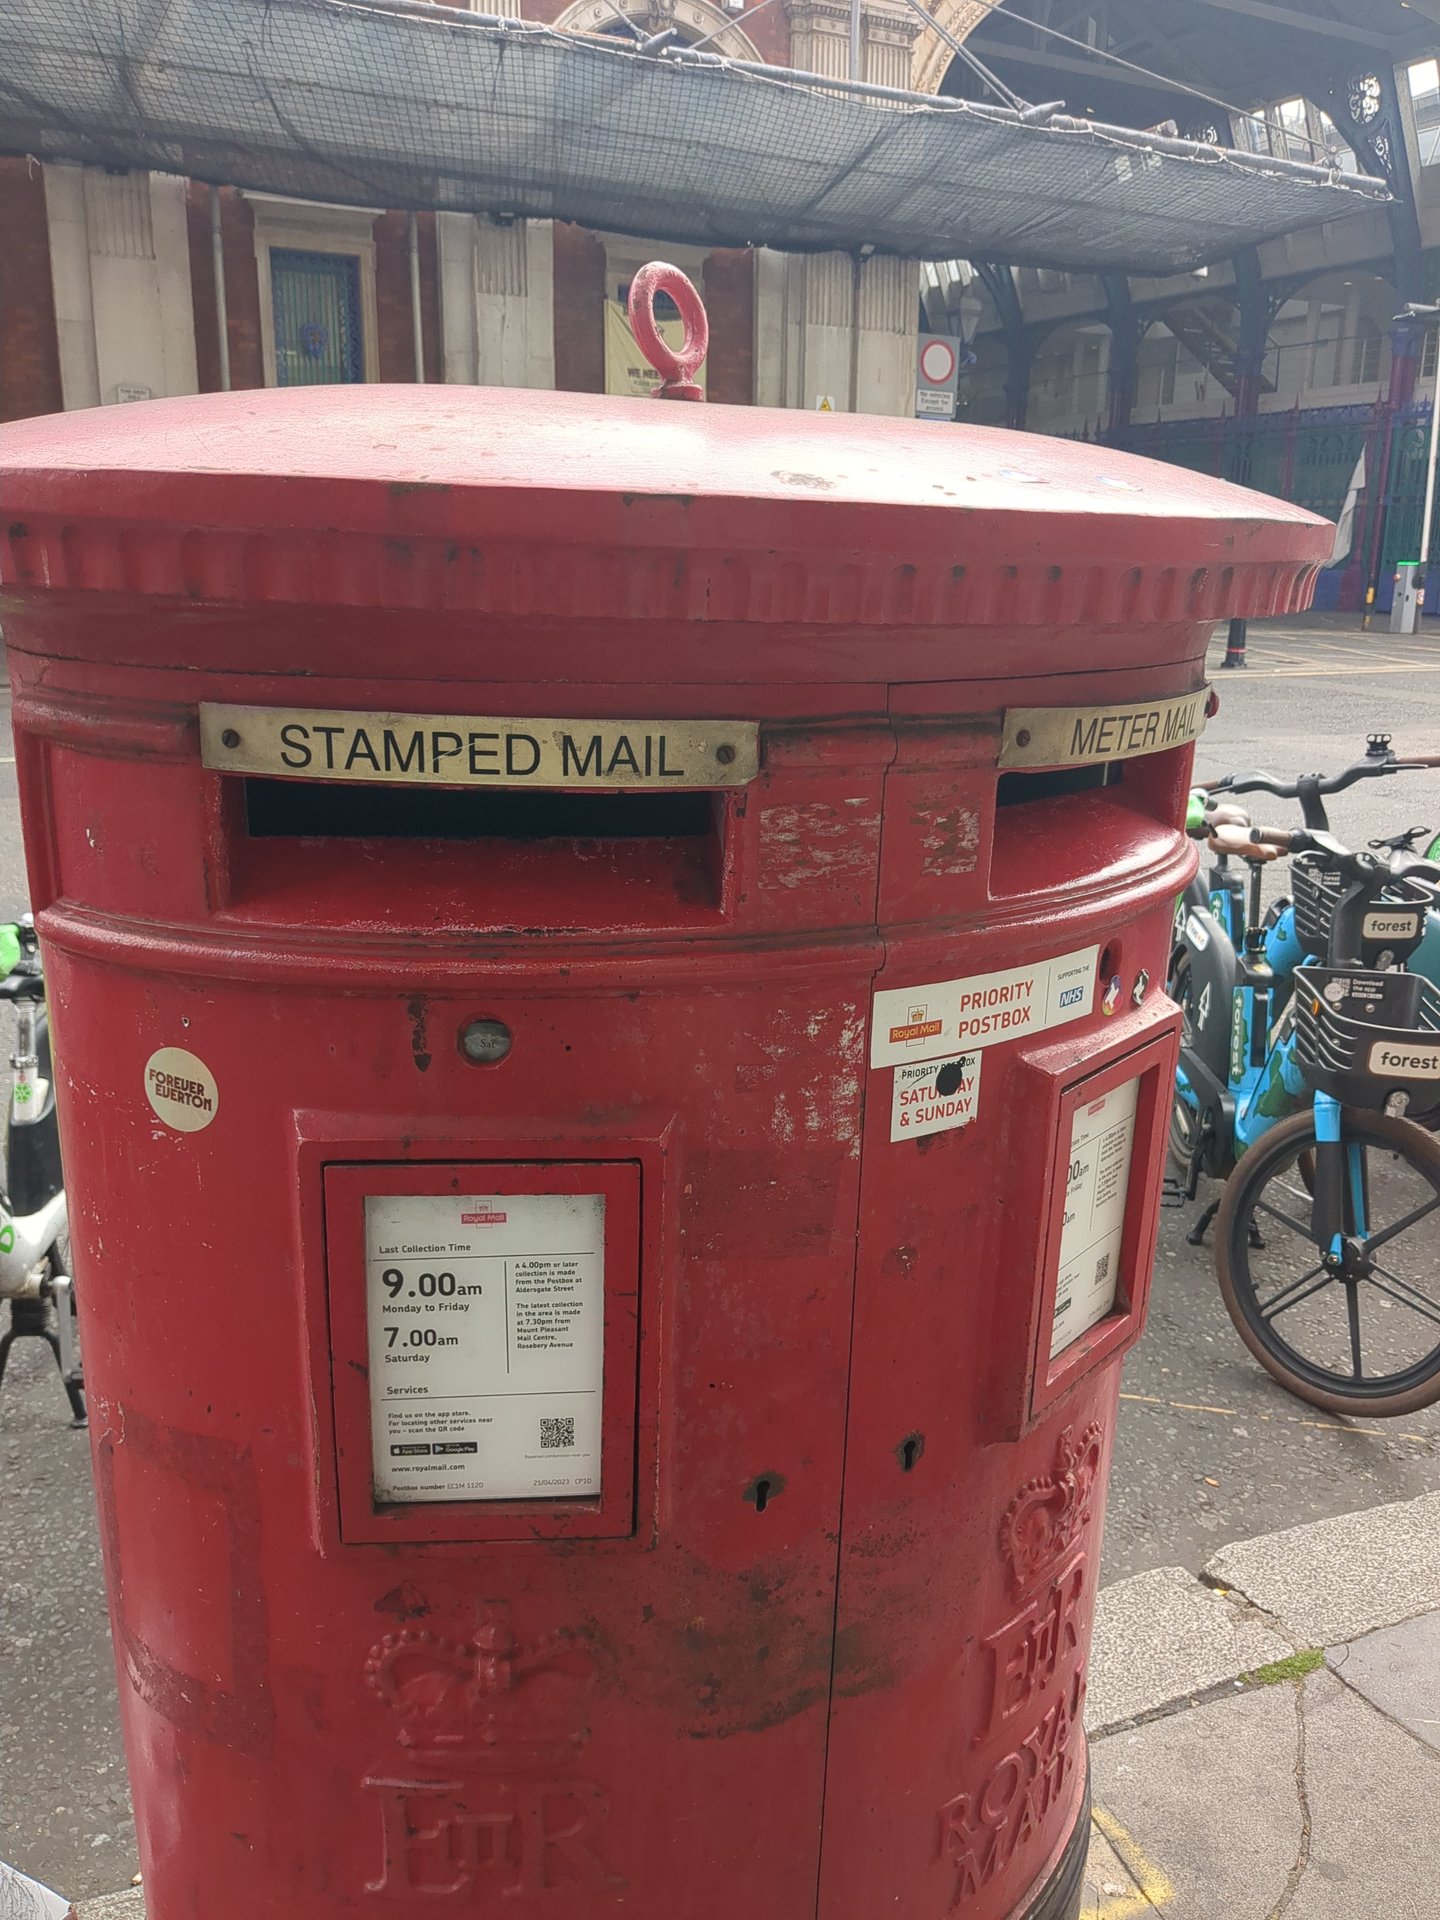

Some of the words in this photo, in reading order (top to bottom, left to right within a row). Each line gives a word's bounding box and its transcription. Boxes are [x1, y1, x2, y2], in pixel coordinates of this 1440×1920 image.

[1070, 711, 1160, 755] METER
[1161, 703, 1196, 743] MAIL
[280, 724, 541, 776] STAMPED
[562, 735, 684, 777] MAIL
[1371, 920, 1412, 932] forest
[1057, 967, 1082, 981] SUPPORTING
[1352, 979, 1384, 987] Download
[960, 980, 1034, 1013] PRIORITY
[1060, 987, 1083, 1006] NHS
[958, 1006, 1032, 1039] POSTBOX
[892, 1025, 919, 1041] Royal
[920, 1021, 940, 1035] Mail
[1380, 1052, 1439, 1070] forest
[901, 1065, 939, 1080] PRIORITY
[900, 1076, 975, 1106] SATUAY
[900, 1112, 910, 1127] &
[915, 1097, 973, 1124] SUNDAY
[463, 1214, 486, 1223] Royal
[487, 1214, 505, 1222] Mail
[379, 1246, 400, 1254] Last
[402, 1244, 446, 1254] Collection
[448, 1243, 471, 1252] Time
[522, 1261, 551, 1269] 4.00pm
[382, 1268, 482, 1298] 9.00am
[382, 1304, 422, 1314] Monday
[425, 1304, 435, 1312] to
[439, 1303, 470, 1313] Friday
[384, 1327, 459, 1348] 7.00am
[385, 1354, 430, 1363] Saturday
[387, 1386, 429, 1395] Services
[391, 1464, 465, 1472] www.royalmail.com
